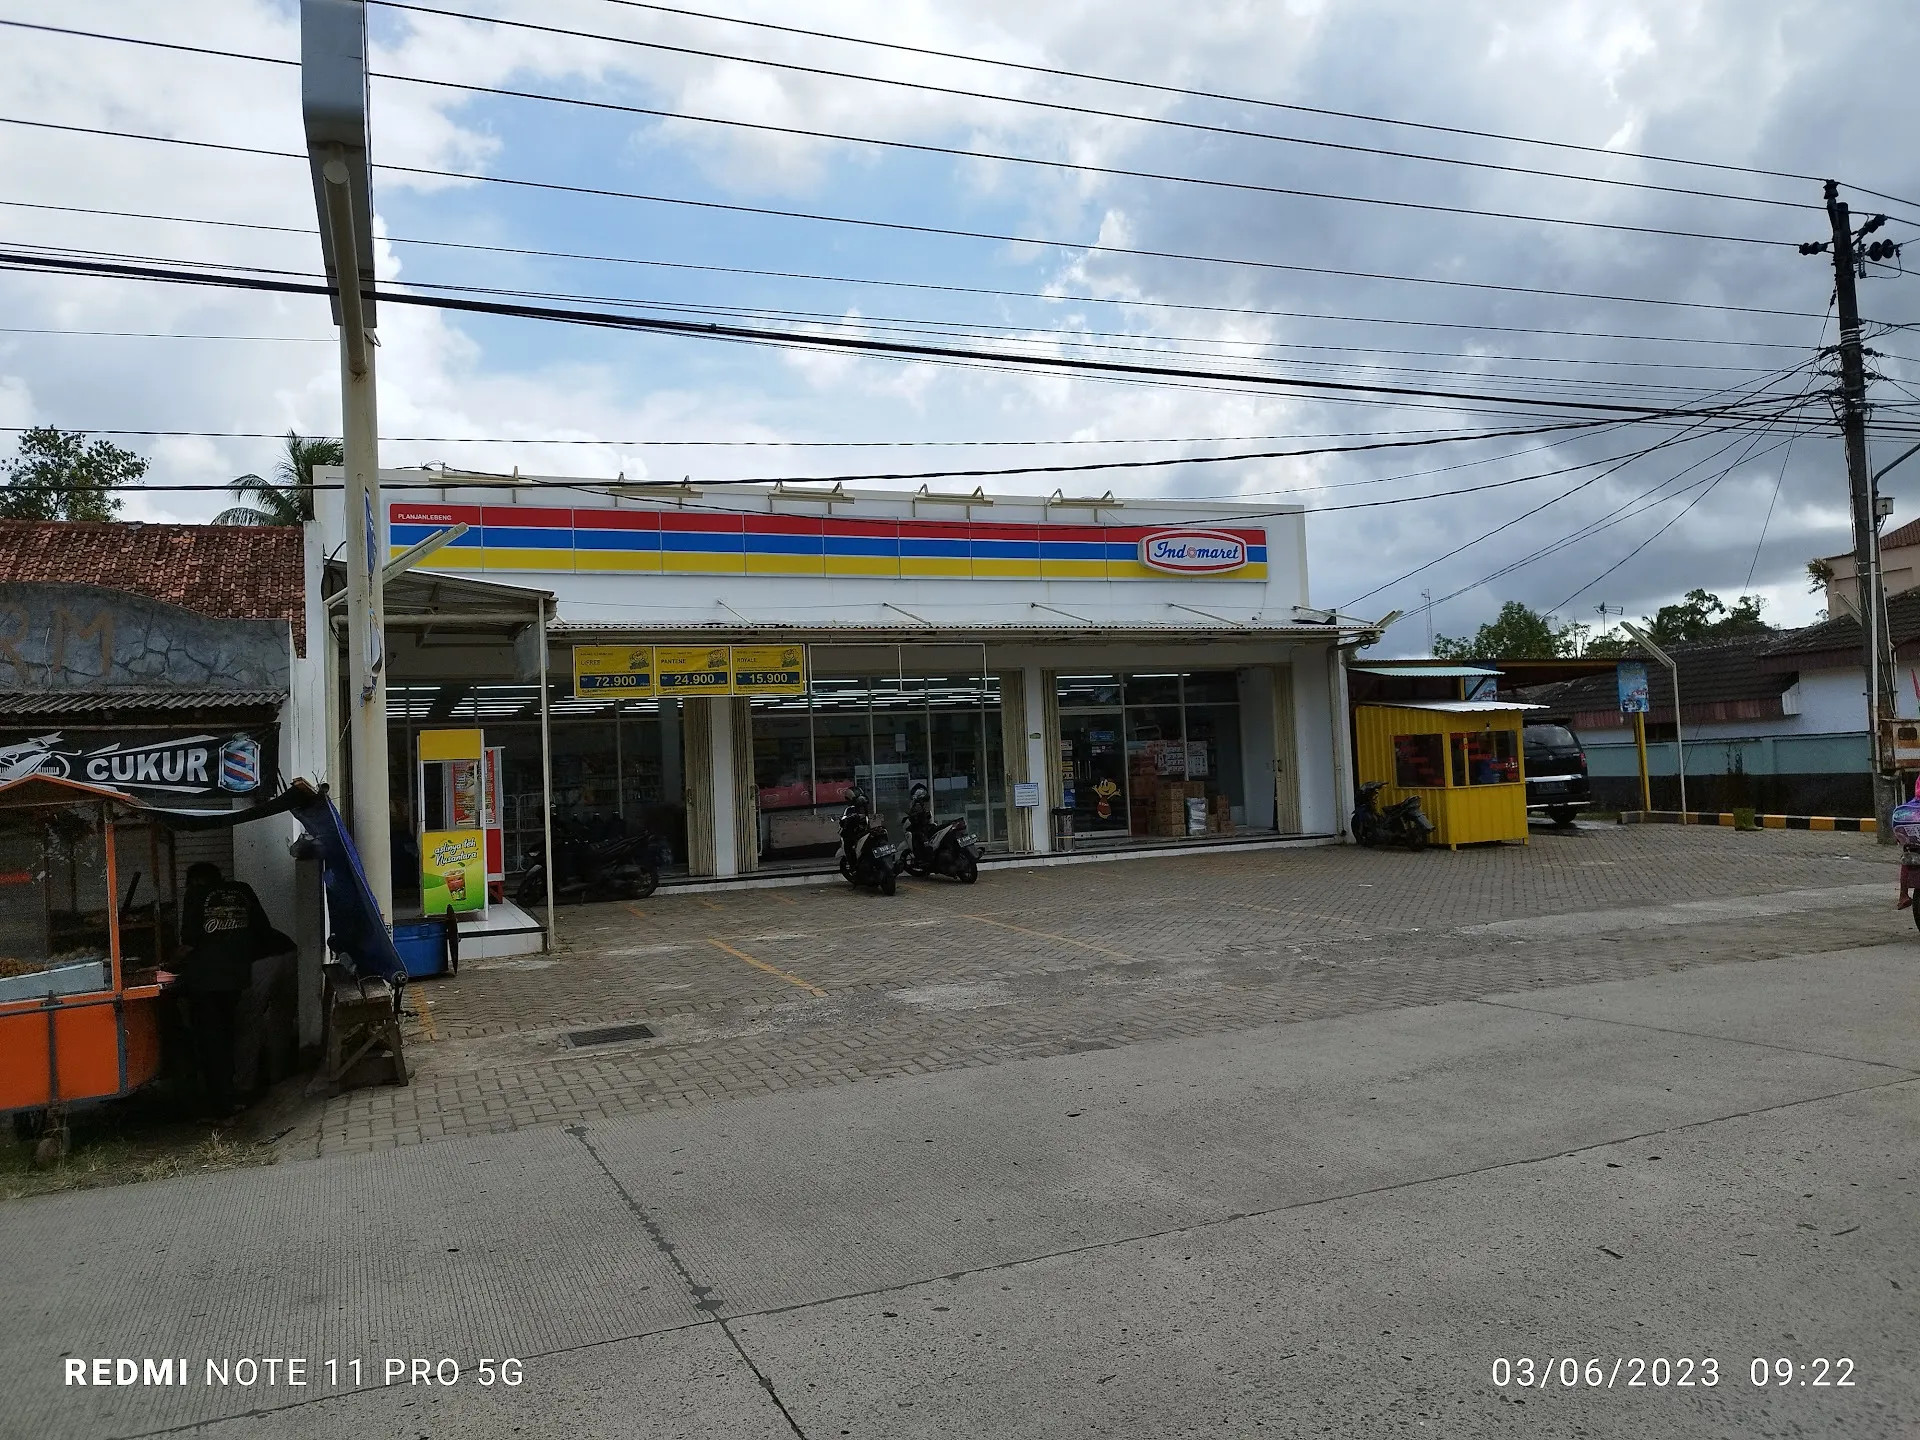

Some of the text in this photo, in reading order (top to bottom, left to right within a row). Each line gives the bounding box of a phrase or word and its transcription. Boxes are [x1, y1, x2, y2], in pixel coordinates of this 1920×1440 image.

[397, 513, 452, 521] PLANJANLEBENG
[1153, 541, 1239, 559] Indomaret
[594, 675, 637, 687] 72.900
[674, 673, 715, 685] 24.900
[750, 673, 788, 684] 15.900
[86, 747, 209, 783] CUKUR
[435, 850, 478, 866] Nusantara
